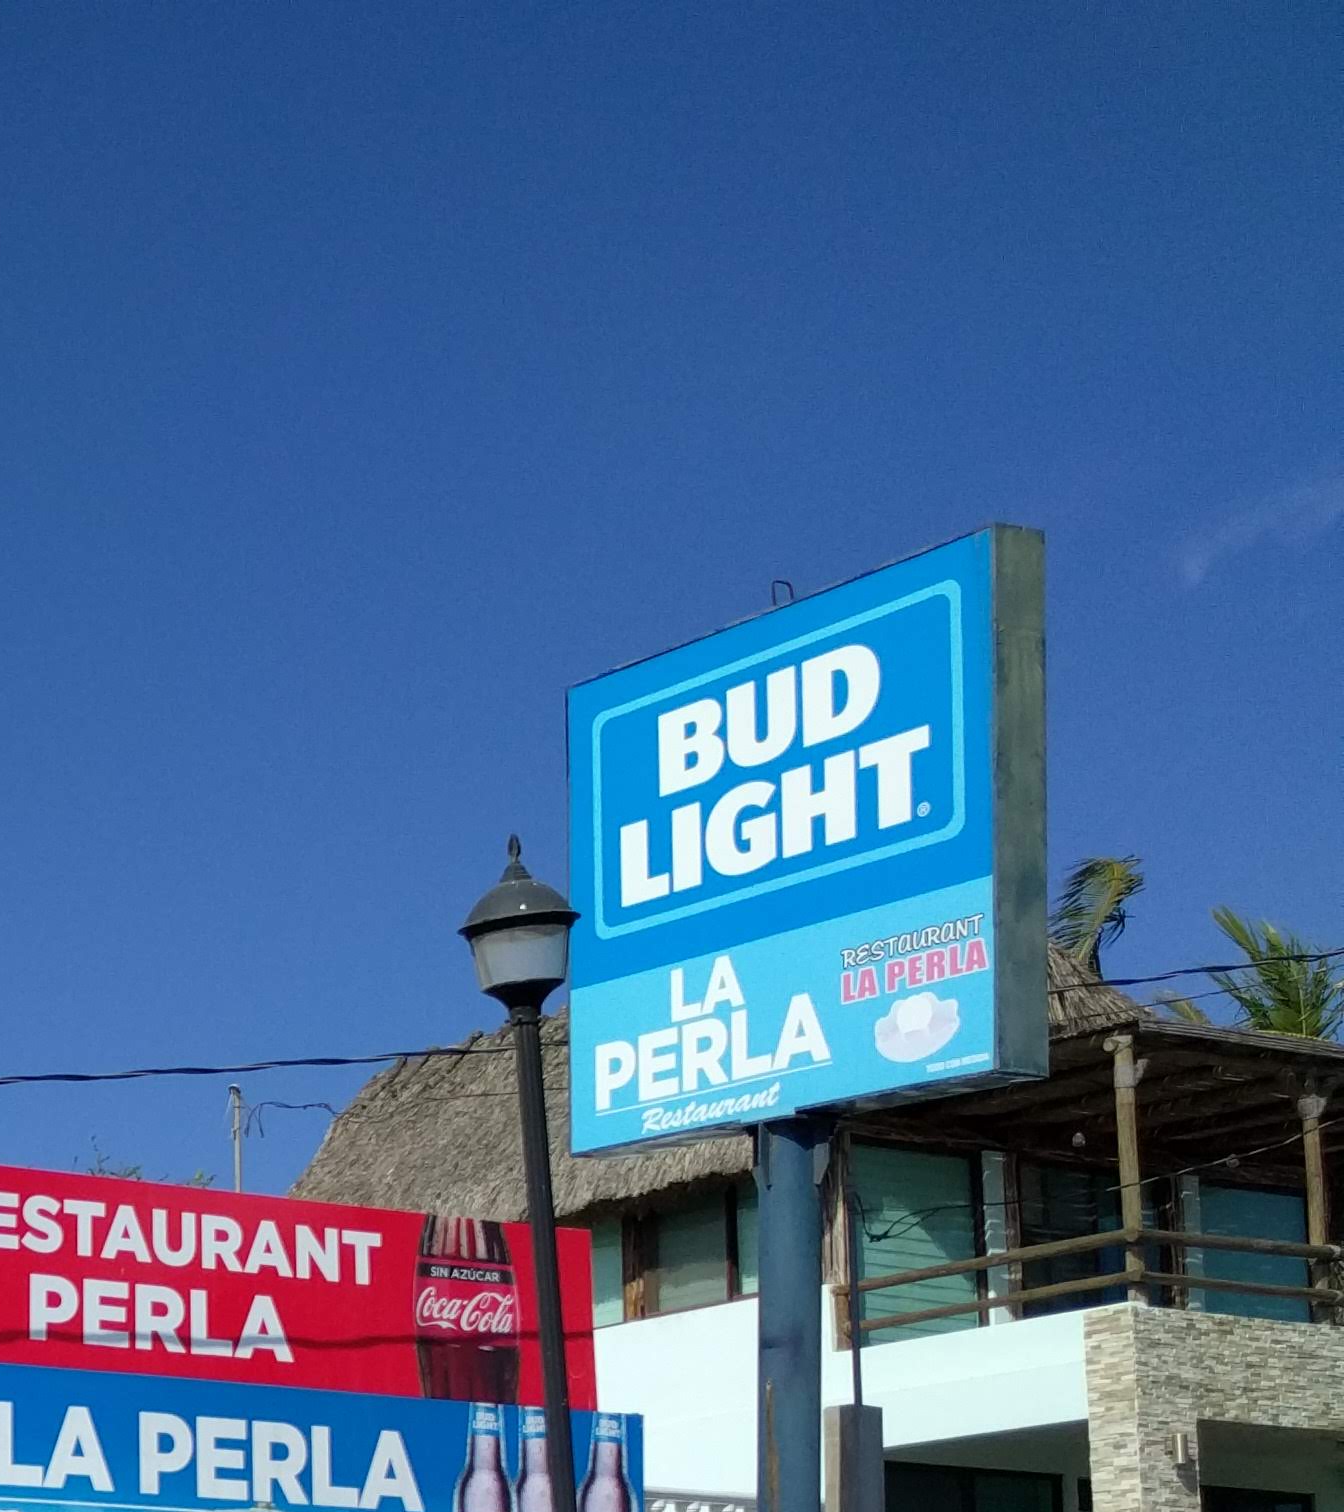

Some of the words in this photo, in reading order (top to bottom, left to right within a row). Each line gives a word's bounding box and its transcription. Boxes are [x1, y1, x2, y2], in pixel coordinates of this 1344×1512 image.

[657, 645, 881, 797] BUD
[620, 725, 931, 907] LIGHT
[670, 954, 744, 1023] LA
[841, 966, 879, 1005] LA
[885, 938, 989, 993] PERLA
[595, 993, 830, 1112] PERLA
[640, 1083, 780, 1134] Restaurant
[430, 1266, 448, 1278] SIN
[451, 1268, 500, 1282] AZÚCAR
[28, 1274, 295, 1364] PERLA
[416, 1286, 514, 1334] Coca-Cola
